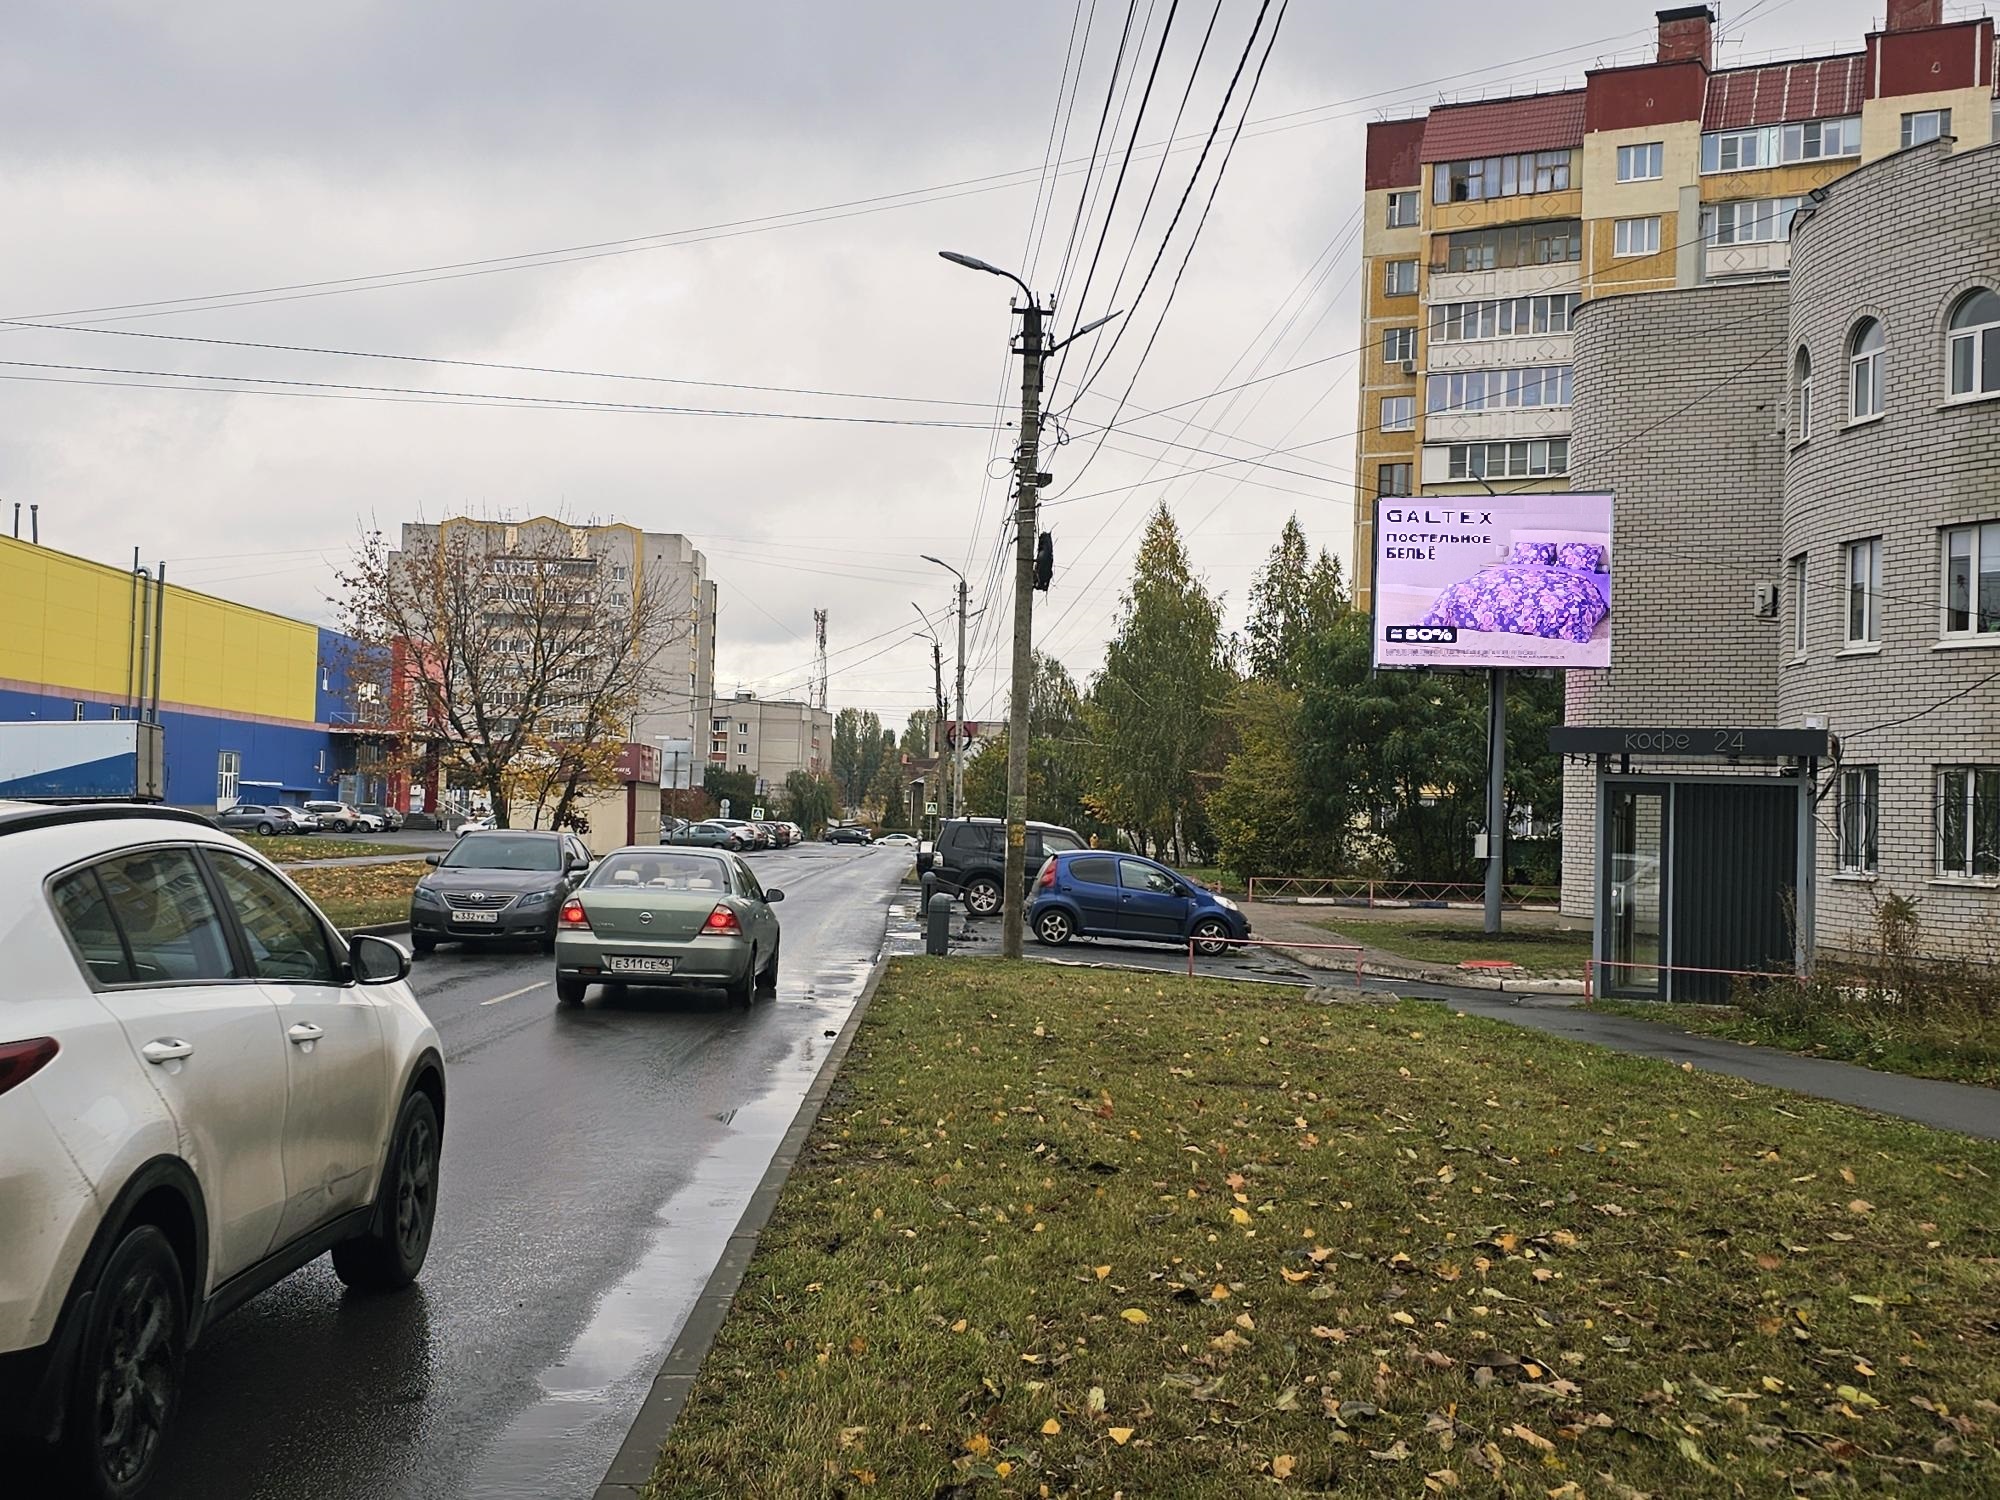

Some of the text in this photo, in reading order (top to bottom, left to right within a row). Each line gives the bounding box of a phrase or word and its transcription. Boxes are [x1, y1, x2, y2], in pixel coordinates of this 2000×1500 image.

[1386, 510, 1493, 524] GALTEX
[1386, 533, 1492, 544] ПОСТЕЛЬНОЕ
[1386, 546, 1436, 560] БЕЛЬЁ
[1625, 730, 1746, 752] кофе 24
